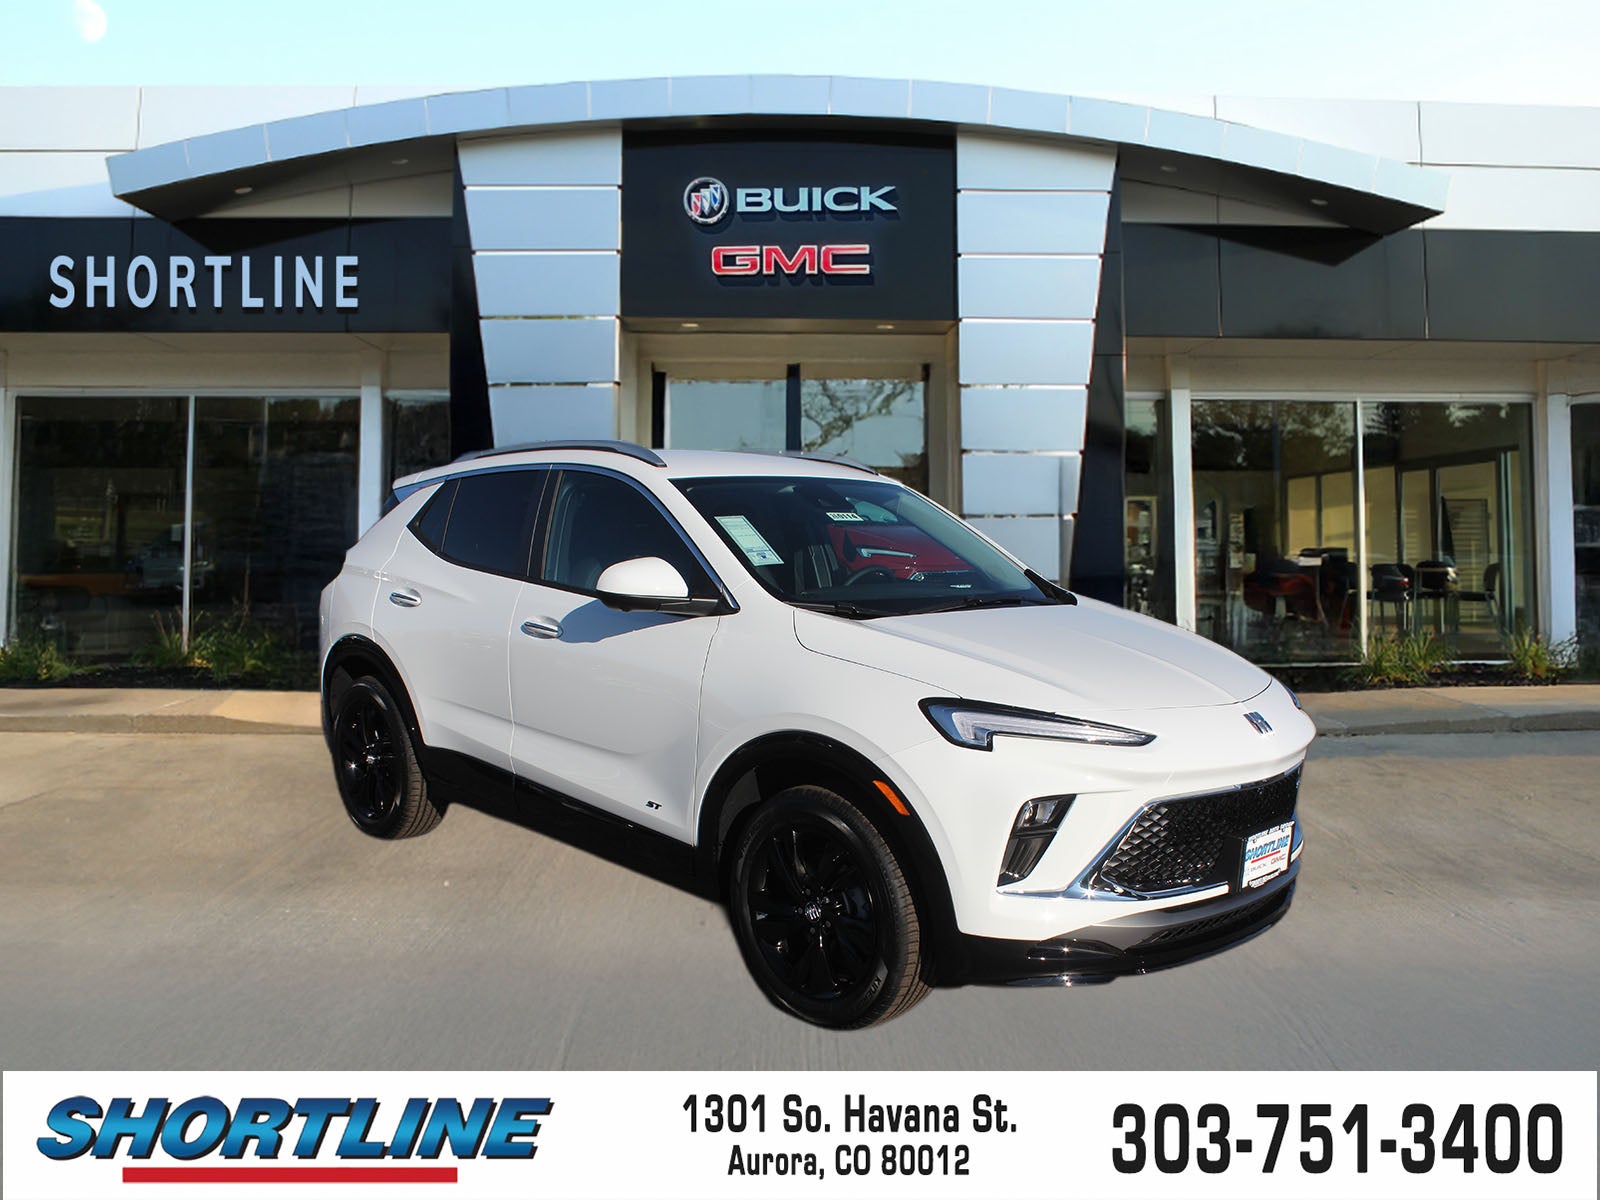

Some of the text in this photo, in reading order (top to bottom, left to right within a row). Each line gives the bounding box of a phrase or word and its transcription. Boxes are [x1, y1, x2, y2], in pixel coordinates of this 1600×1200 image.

[736, 186, 897, 212] BUICK
[711, 244, 870, 275] GMC
[50, 256, 358, 308] SHORTLINE
[645, 800, 662, 810] ST
[1245, 835, 1290, 861] SHORTLINE
